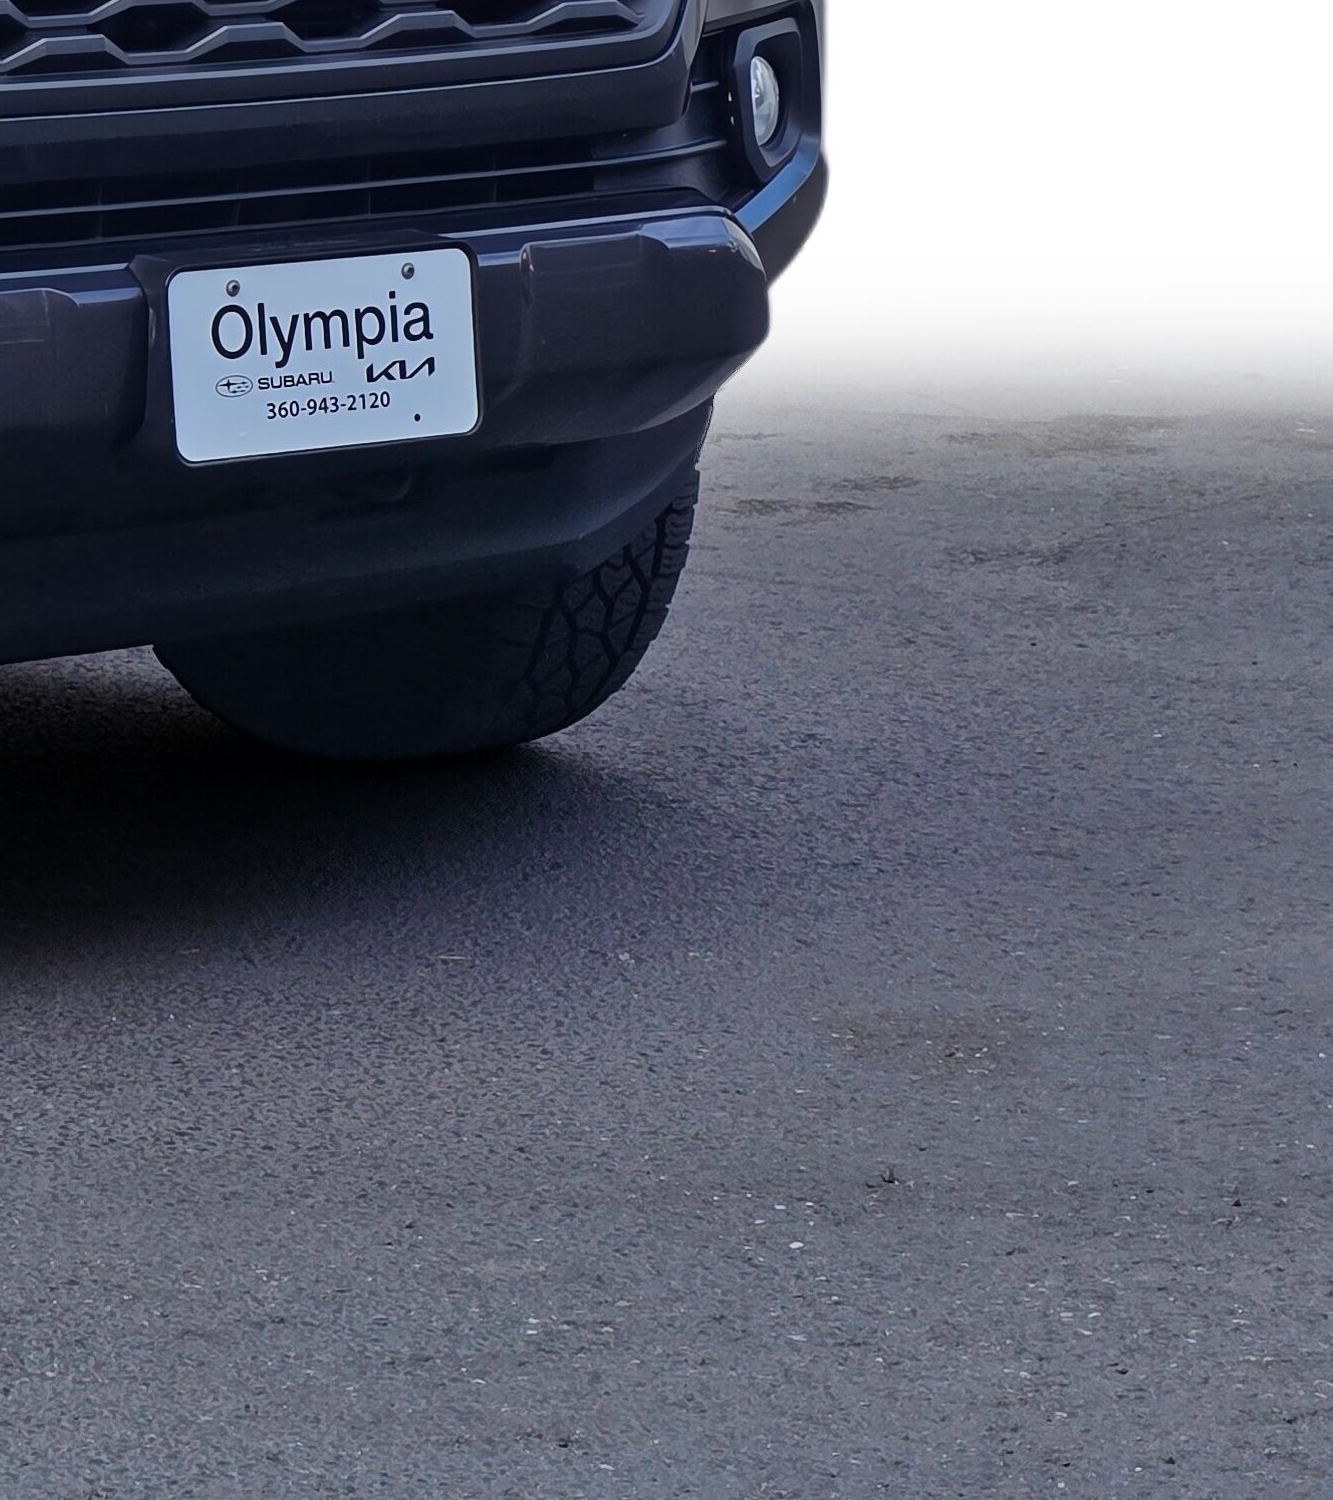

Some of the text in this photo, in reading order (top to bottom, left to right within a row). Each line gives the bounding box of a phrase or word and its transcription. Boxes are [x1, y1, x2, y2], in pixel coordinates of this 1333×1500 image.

[211, 290, 434, 369] Olympia
[257, 370, 333, 391] SUBARU
[266, 390, 391, 420] 360-943-2120
